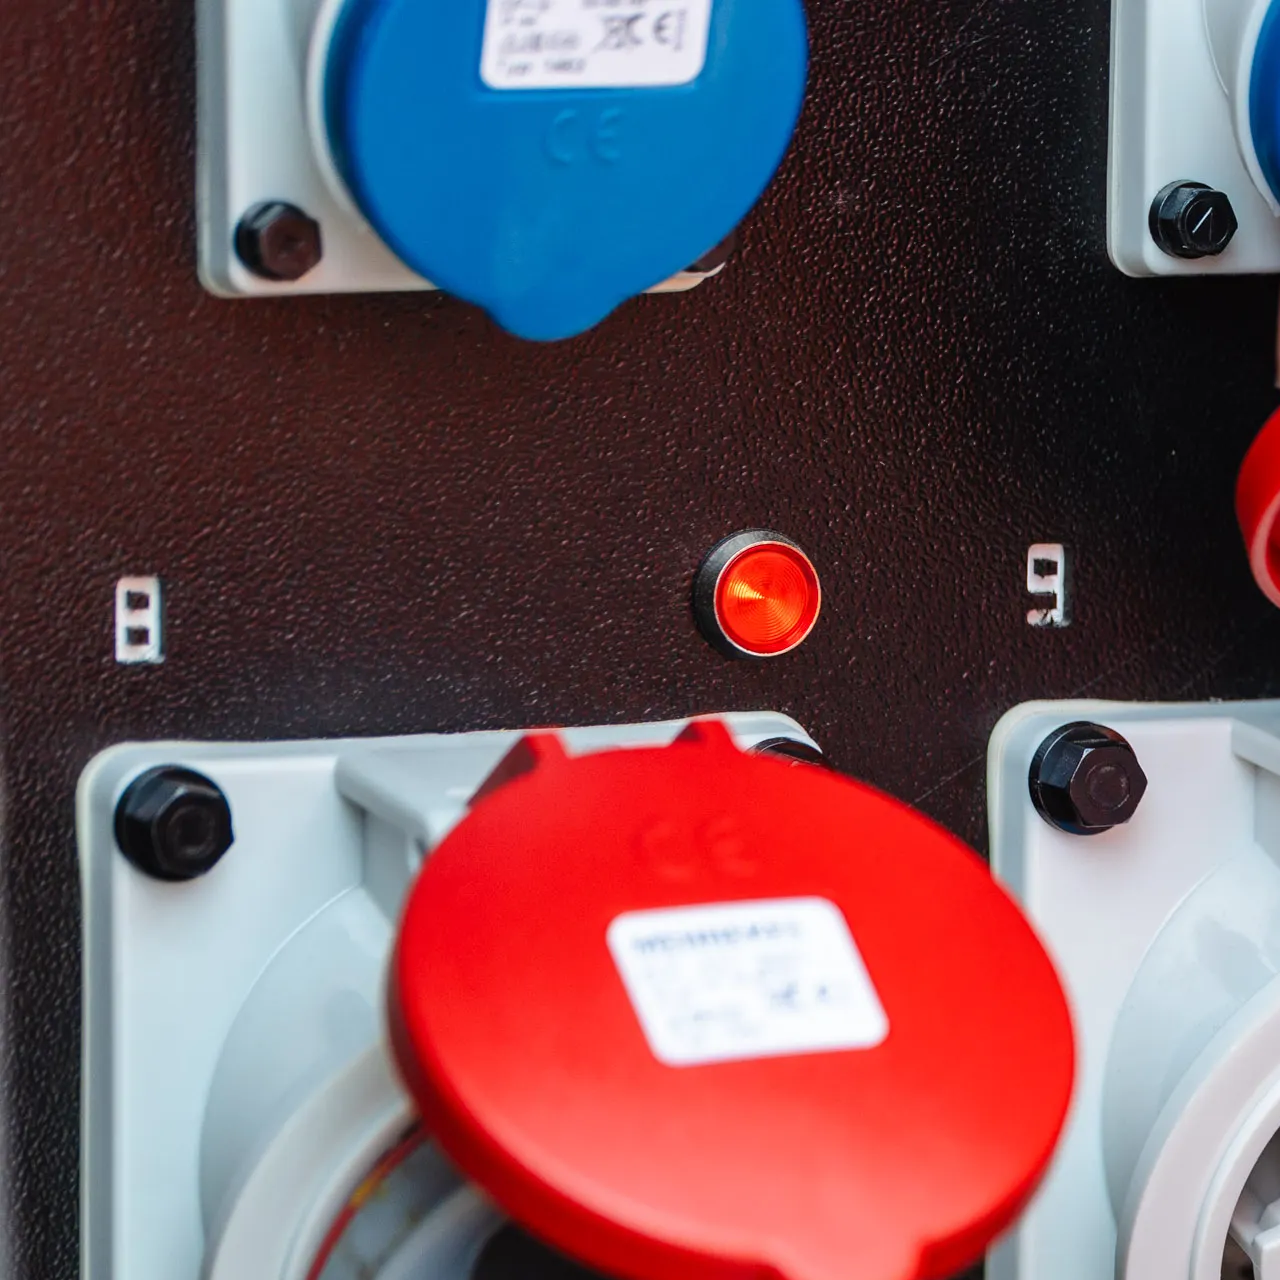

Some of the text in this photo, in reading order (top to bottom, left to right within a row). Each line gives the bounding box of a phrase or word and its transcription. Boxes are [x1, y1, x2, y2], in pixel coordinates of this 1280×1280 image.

[543, 106, 625, 165] CE
[115, 575, 163, 664] 8
[1027, 543, 1067, 628] 9
